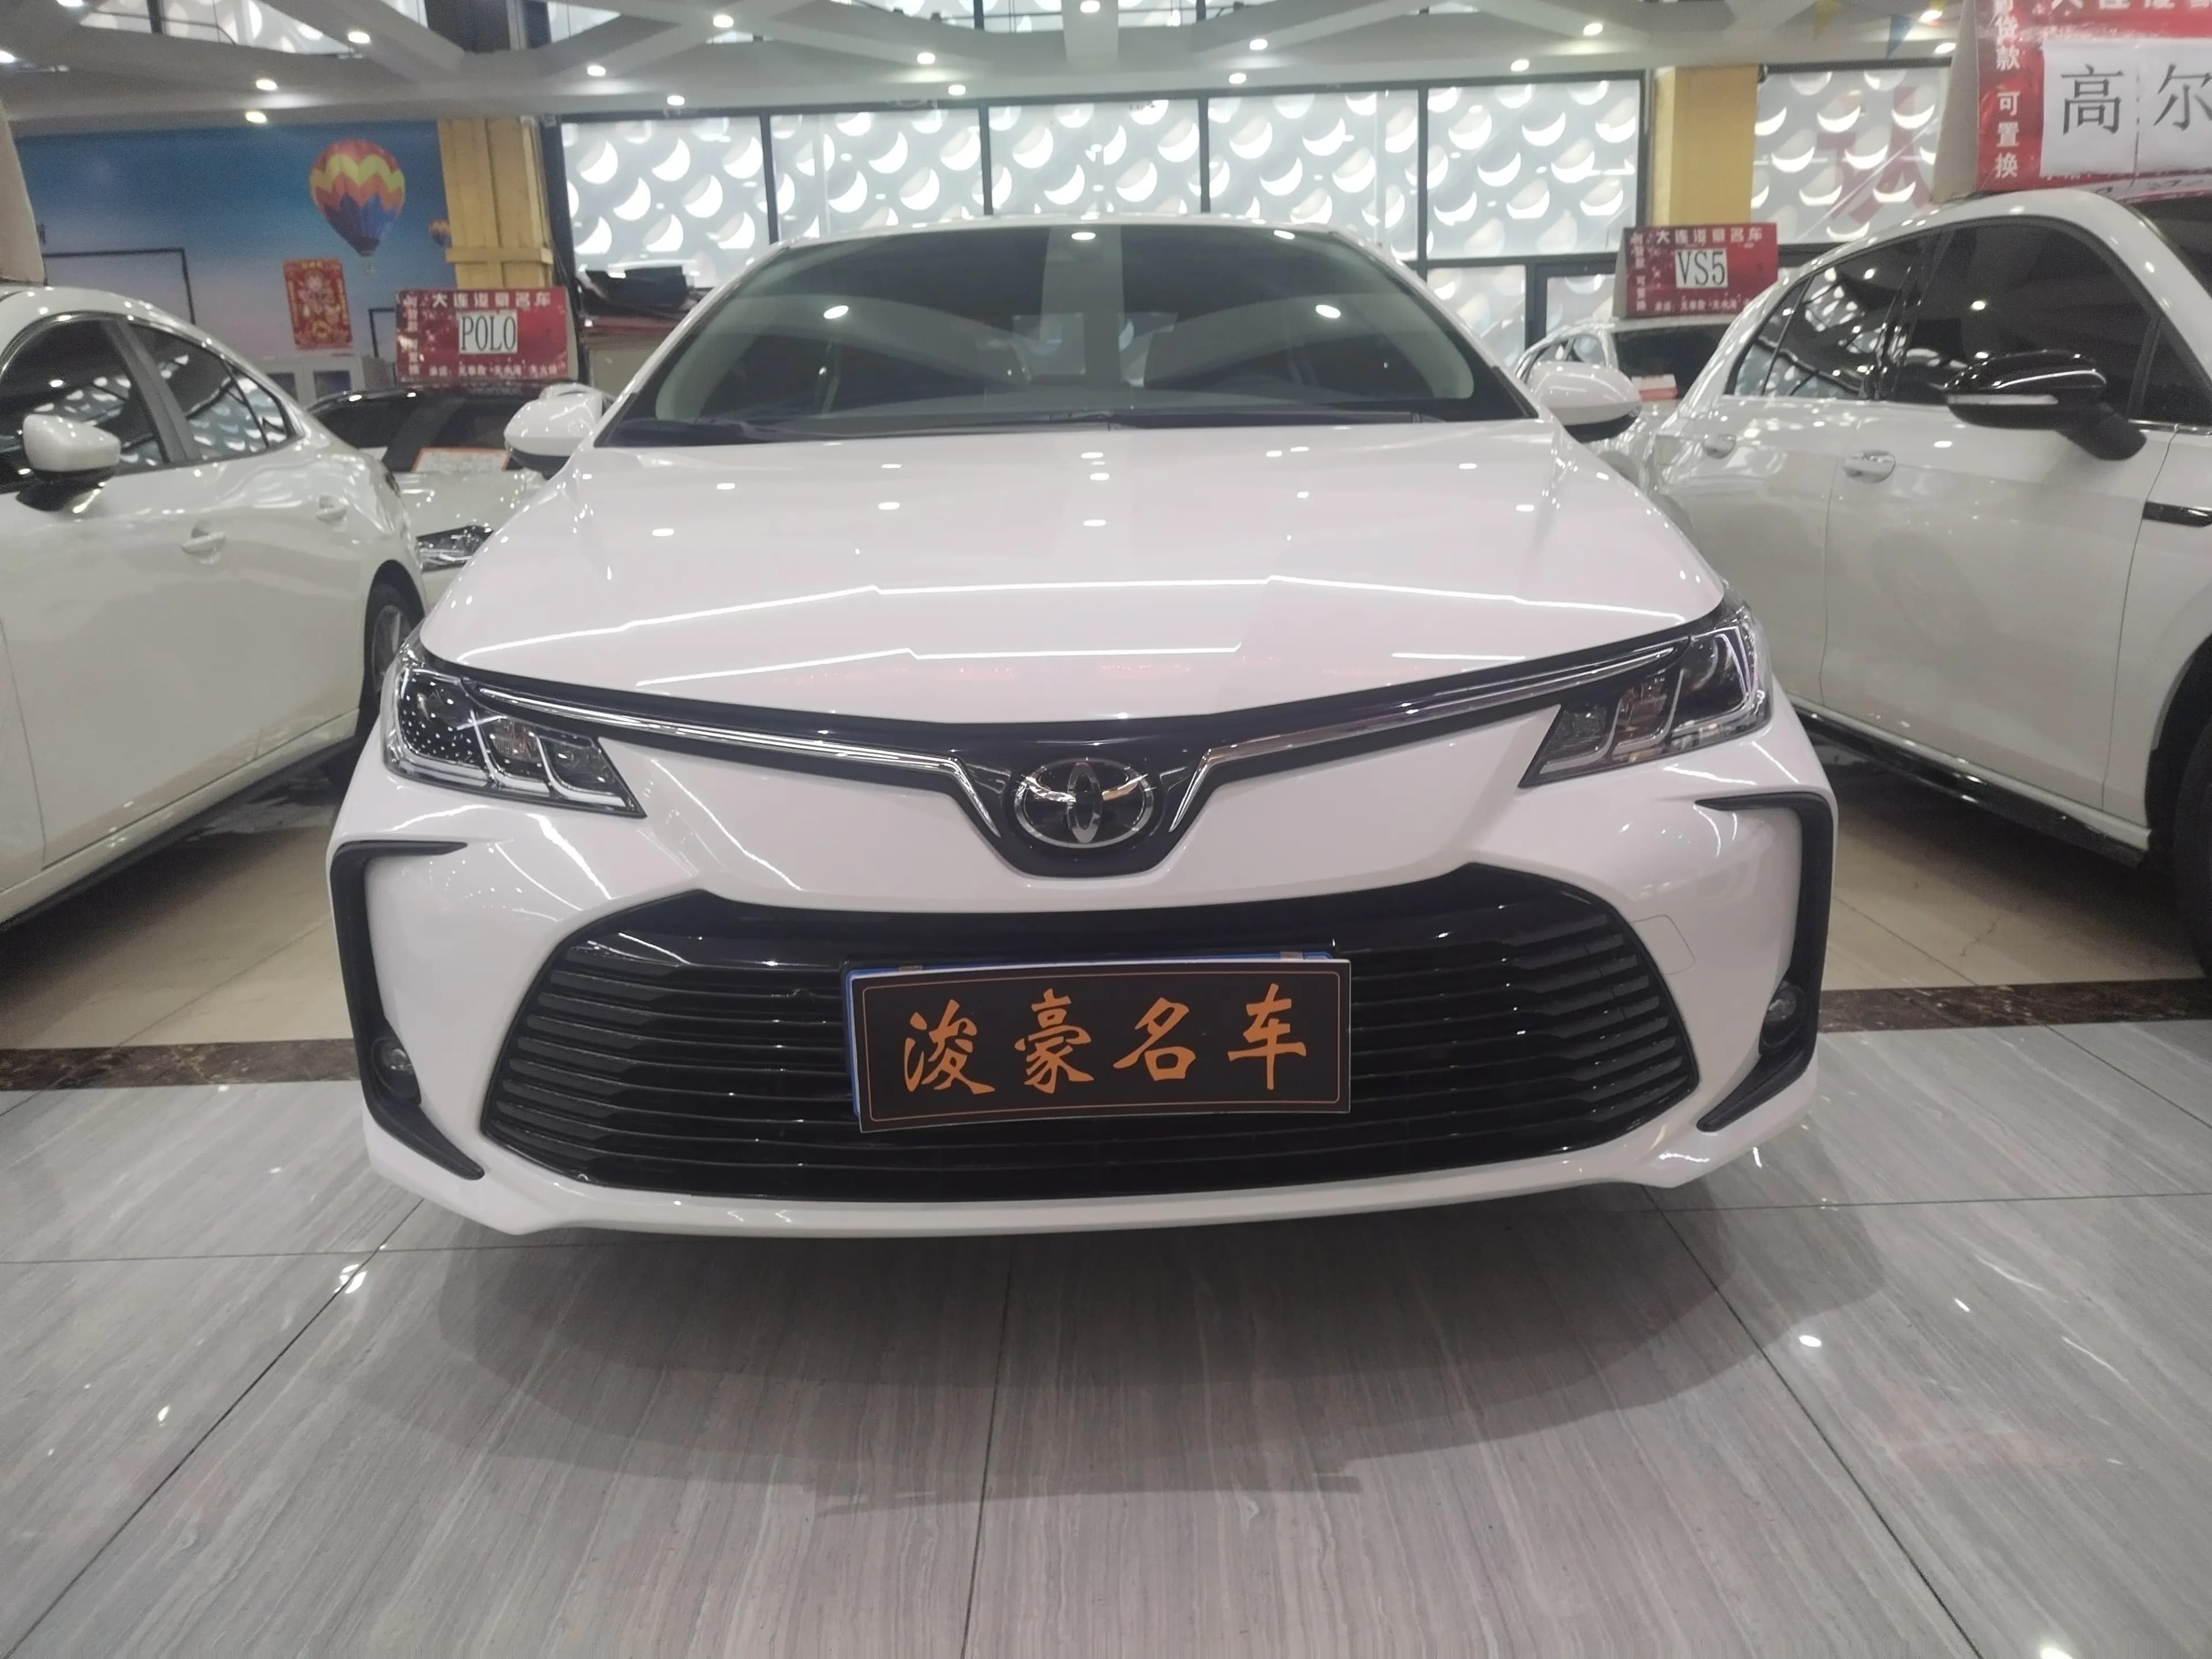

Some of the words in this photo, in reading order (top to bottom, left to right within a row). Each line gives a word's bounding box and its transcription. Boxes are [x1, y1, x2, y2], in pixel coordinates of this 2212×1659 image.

[1677, 251, 1725, 285] VS5
[461, 316, 516, 351] POLO
[903, 983, 1306, 1094] 浚豪名车
